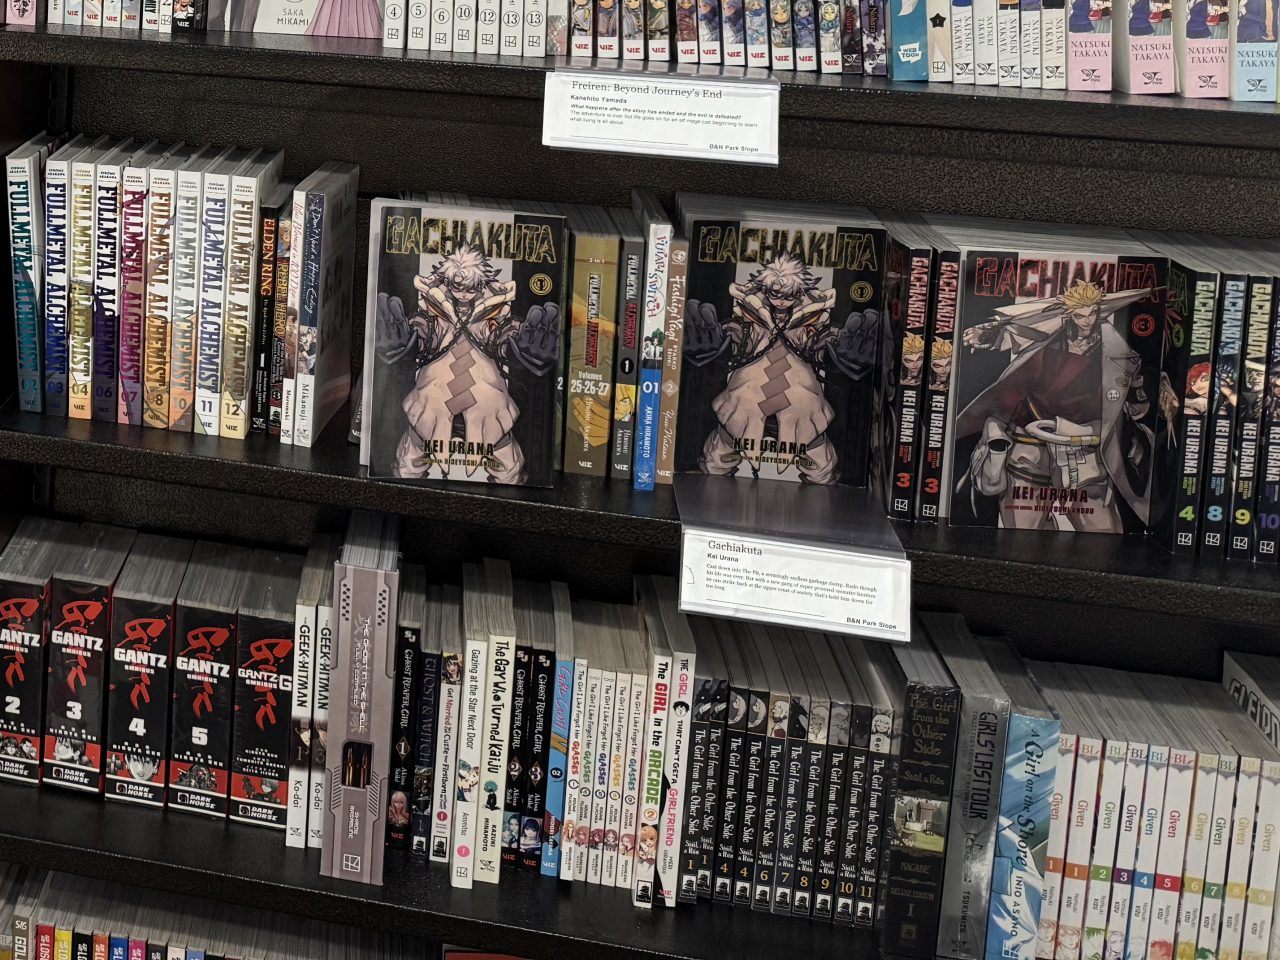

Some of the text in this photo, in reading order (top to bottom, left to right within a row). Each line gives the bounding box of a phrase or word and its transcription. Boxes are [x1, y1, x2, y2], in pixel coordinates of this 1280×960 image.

[282, 8, 304, 17] SAKA
[277, 17, 309, 26] MIKAMI
[1071, 40, 1111, 49] NATSUKI
[1072, 49, 1108, 58] TAKAYA
[571, 94, 600, 102] Kanehito
[572, 81, 722, 99] Freiren: Beyond Journey's End
[197, 197, 226, 394] FULLMETAL ALCHEMIST
[570, 380, 609, 397] 25-26-27
[642, 381, 658, 394] 01
[201, 400, 212, 413] 11
[424, 438, 494, 457] KEI URANA
[1178, 505, 1195, 522] 4
[1206, 505, 1223, 522] 8
[1234, 510, 1251, 526] 9
[1259, 512, 1279, 530] 10
[708, 541, 762, 556] Gachiakuta
[719, 555, 739, 563] Urana
[879, 622, 897, 630] Slope
[0, 644, 29, 653] OMNIBUS
[657, 661, 668, 679] The
[5, 696, 20, 714] 2
[653, 683, 668, 714] GIRL
[66, 701, 82, 720] 3
[128, 717, 146, 736] 4
[191, 727, 208, 745] 5
[4, 761, 25, 769] DARK
[4, 767, 29, 776] HORSE
[645, 749, 663, 805] ARCADE
[1168, 809, 1181, 839] Given
[1164, 878, 1171, 888] 5
[1009, 875, 1023, 938] INIO ASANO
